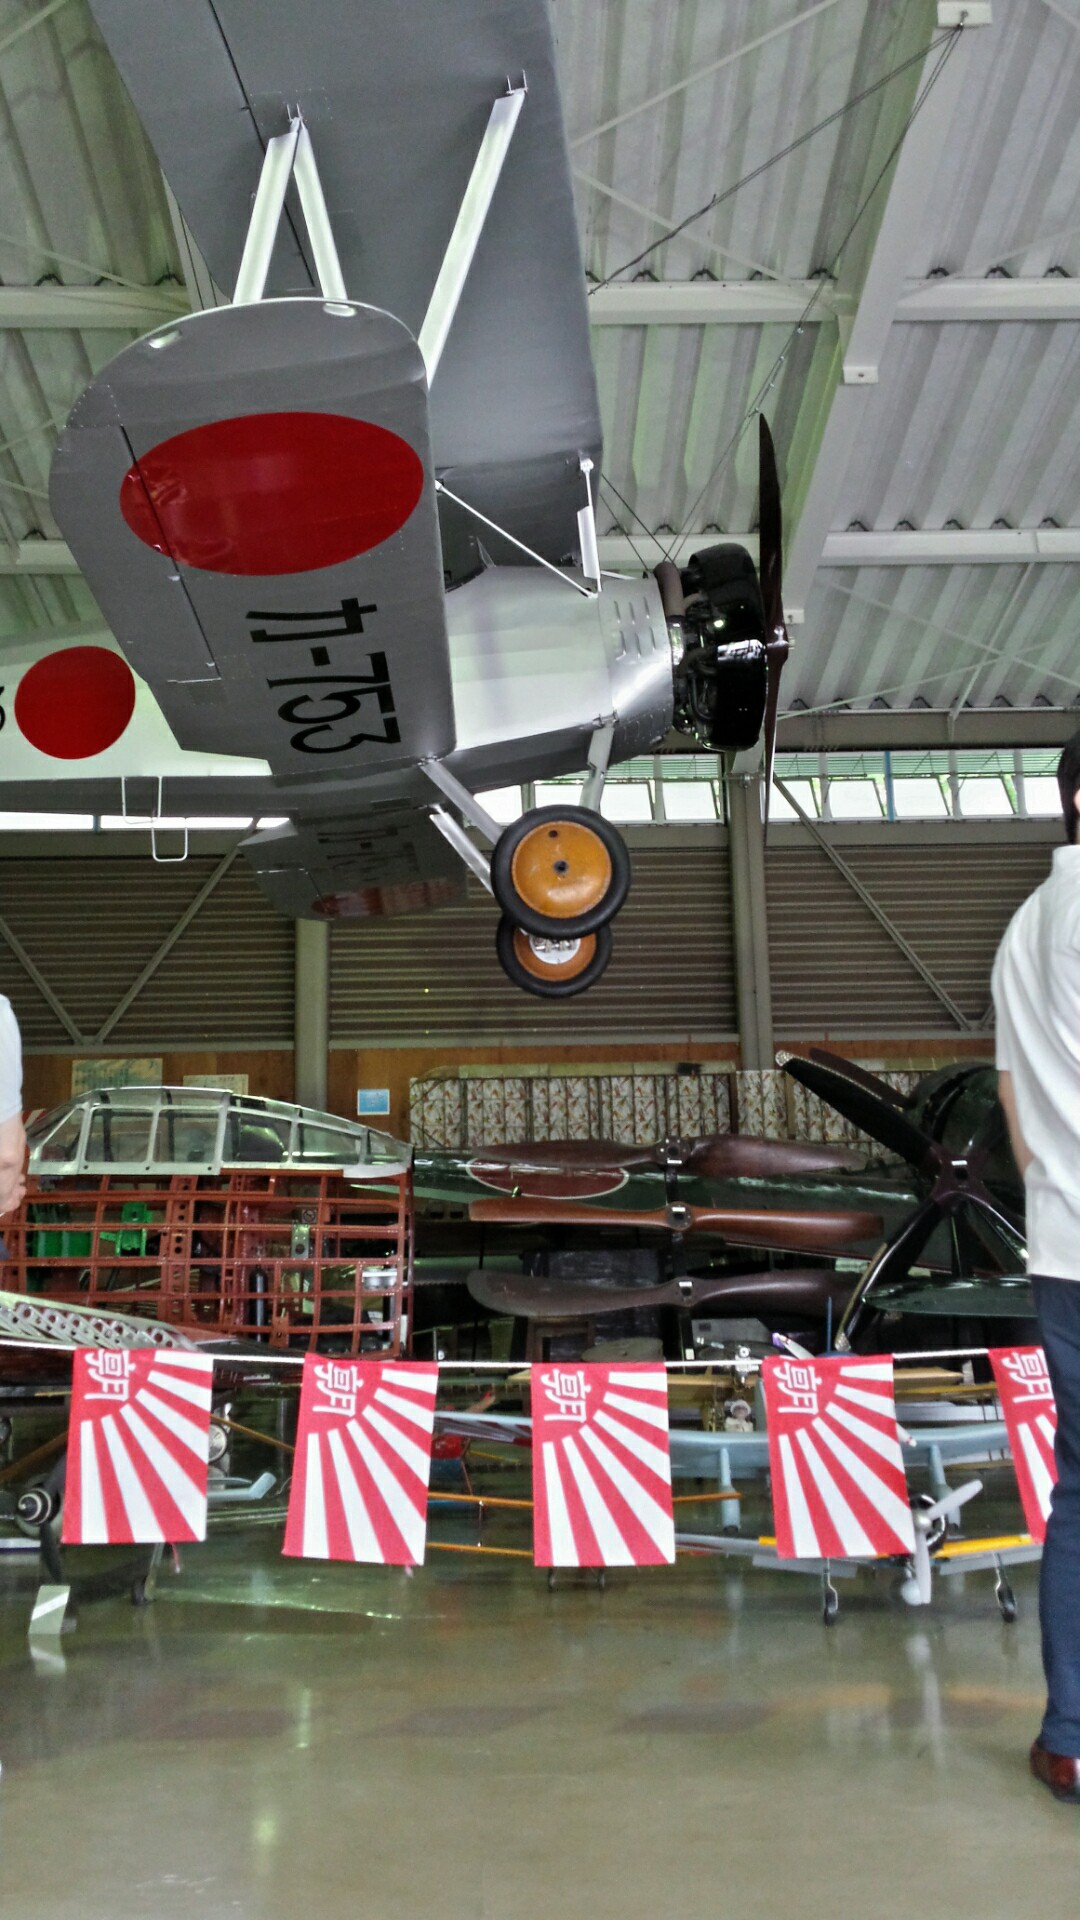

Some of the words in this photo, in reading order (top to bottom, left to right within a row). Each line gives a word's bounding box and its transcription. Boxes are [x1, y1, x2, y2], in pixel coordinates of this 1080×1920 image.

[84, 1348, 136, 1402] 朝
[312, 1361, 363, 1418] 朝
[540, 1369, 591, 1423] 朝
[773, 1361, 822, 1416] 朝
[1001, 1348, 1055, 1404] 朝
